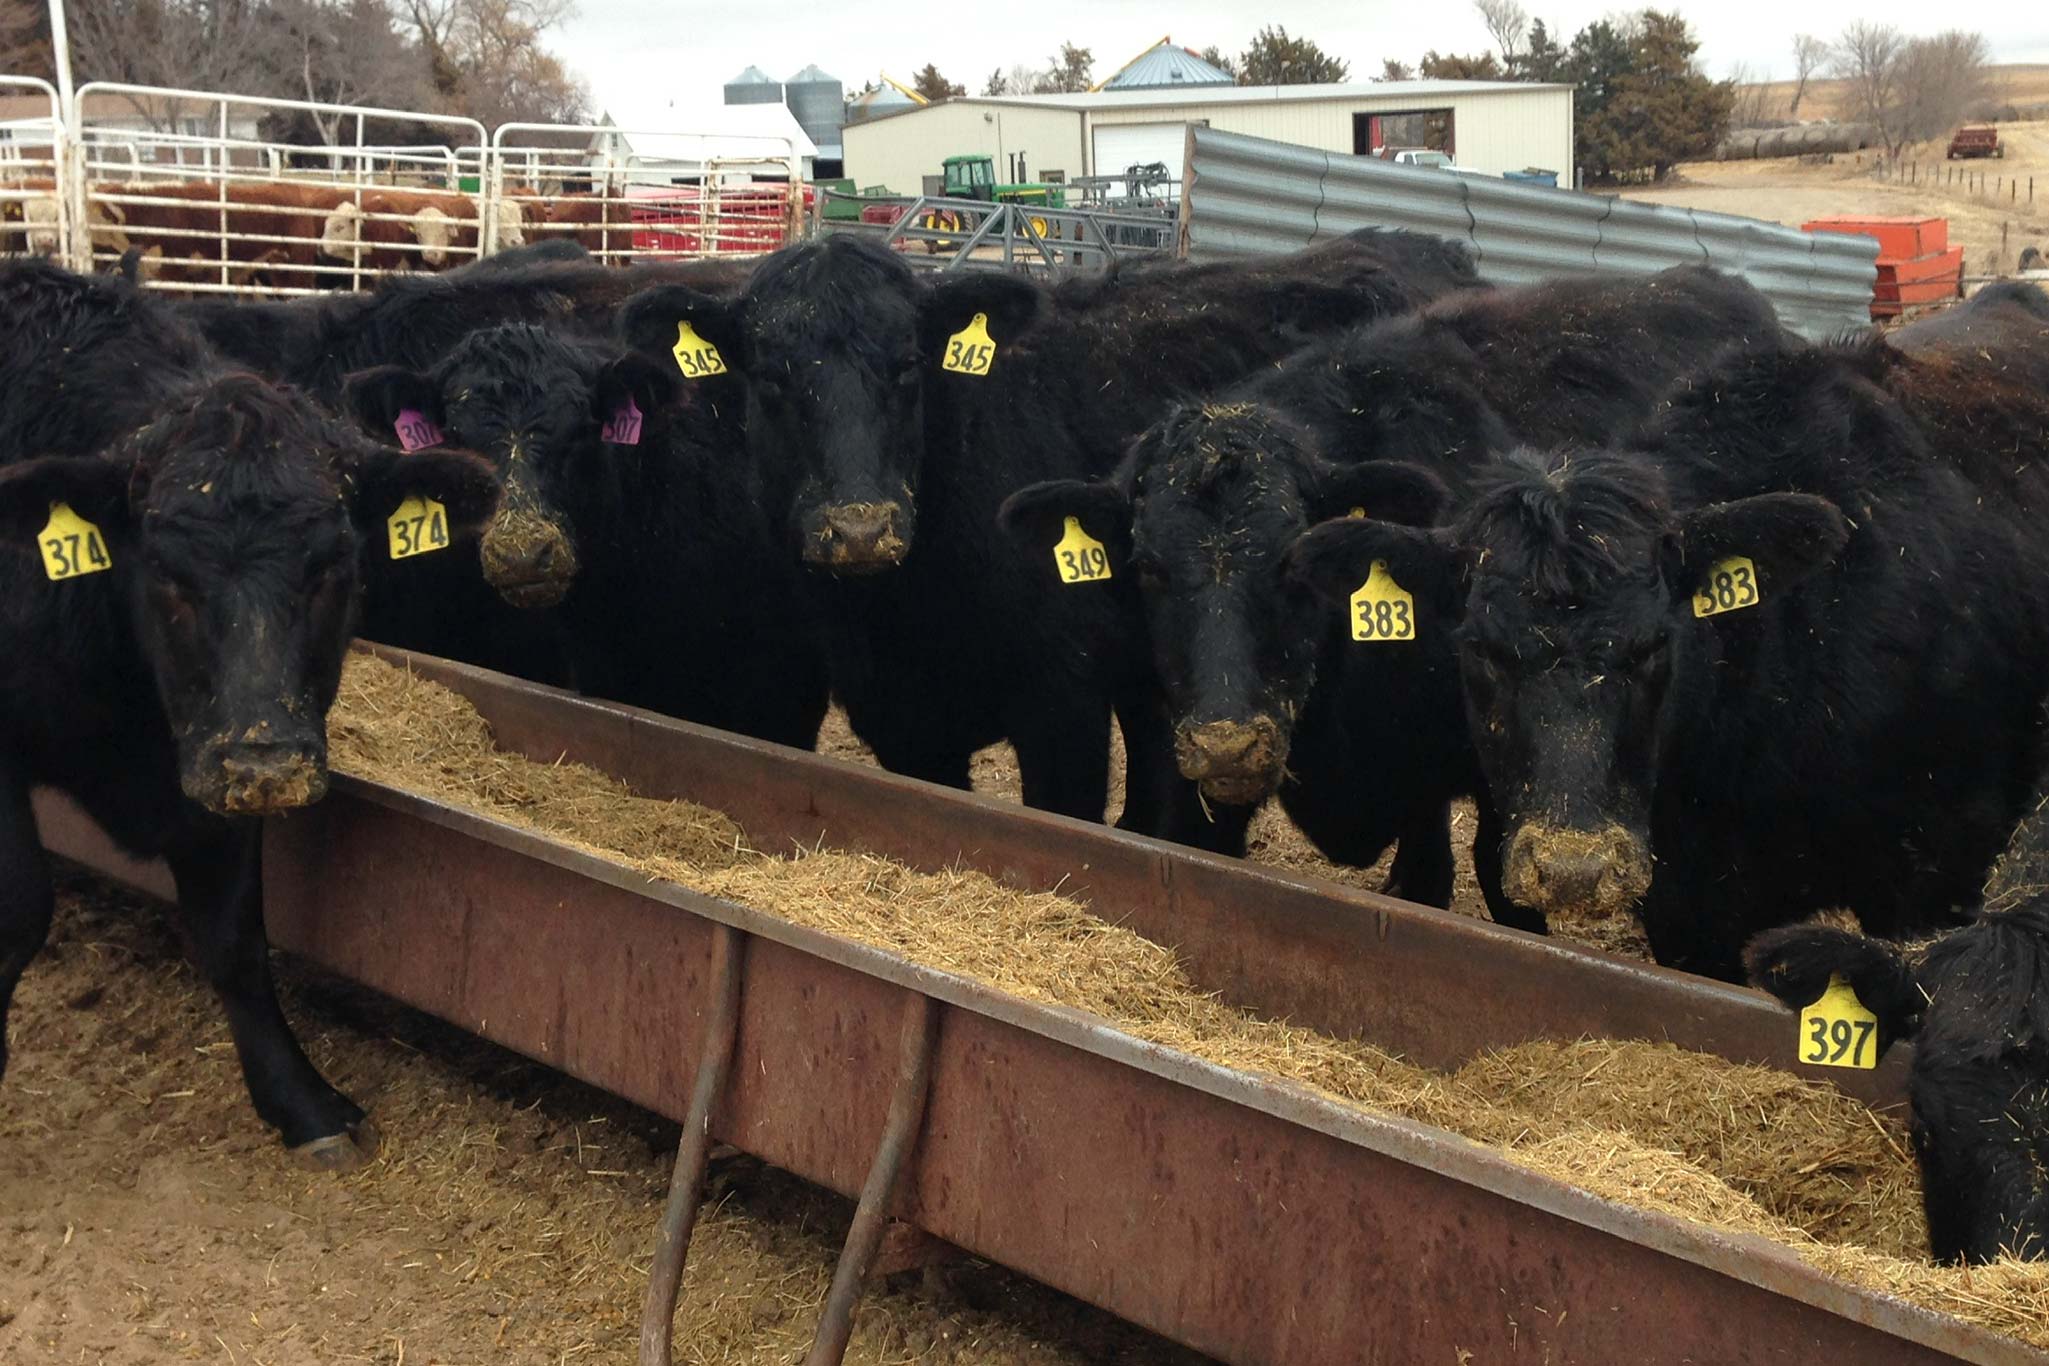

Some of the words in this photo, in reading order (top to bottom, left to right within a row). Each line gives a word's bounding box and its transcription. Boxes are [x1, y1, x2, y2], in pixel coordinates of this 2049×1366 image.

[679, 348, 722, 375] 345
[947, 341, 991, 371] 345
[394, 511, 447, 555] 374
[46, 531, 106, 576] 374
[1062, 547, 1105, 580] 349
[1356, 600, 1411, 638] 383
[1808, 1017, 1874, 1066] 397
